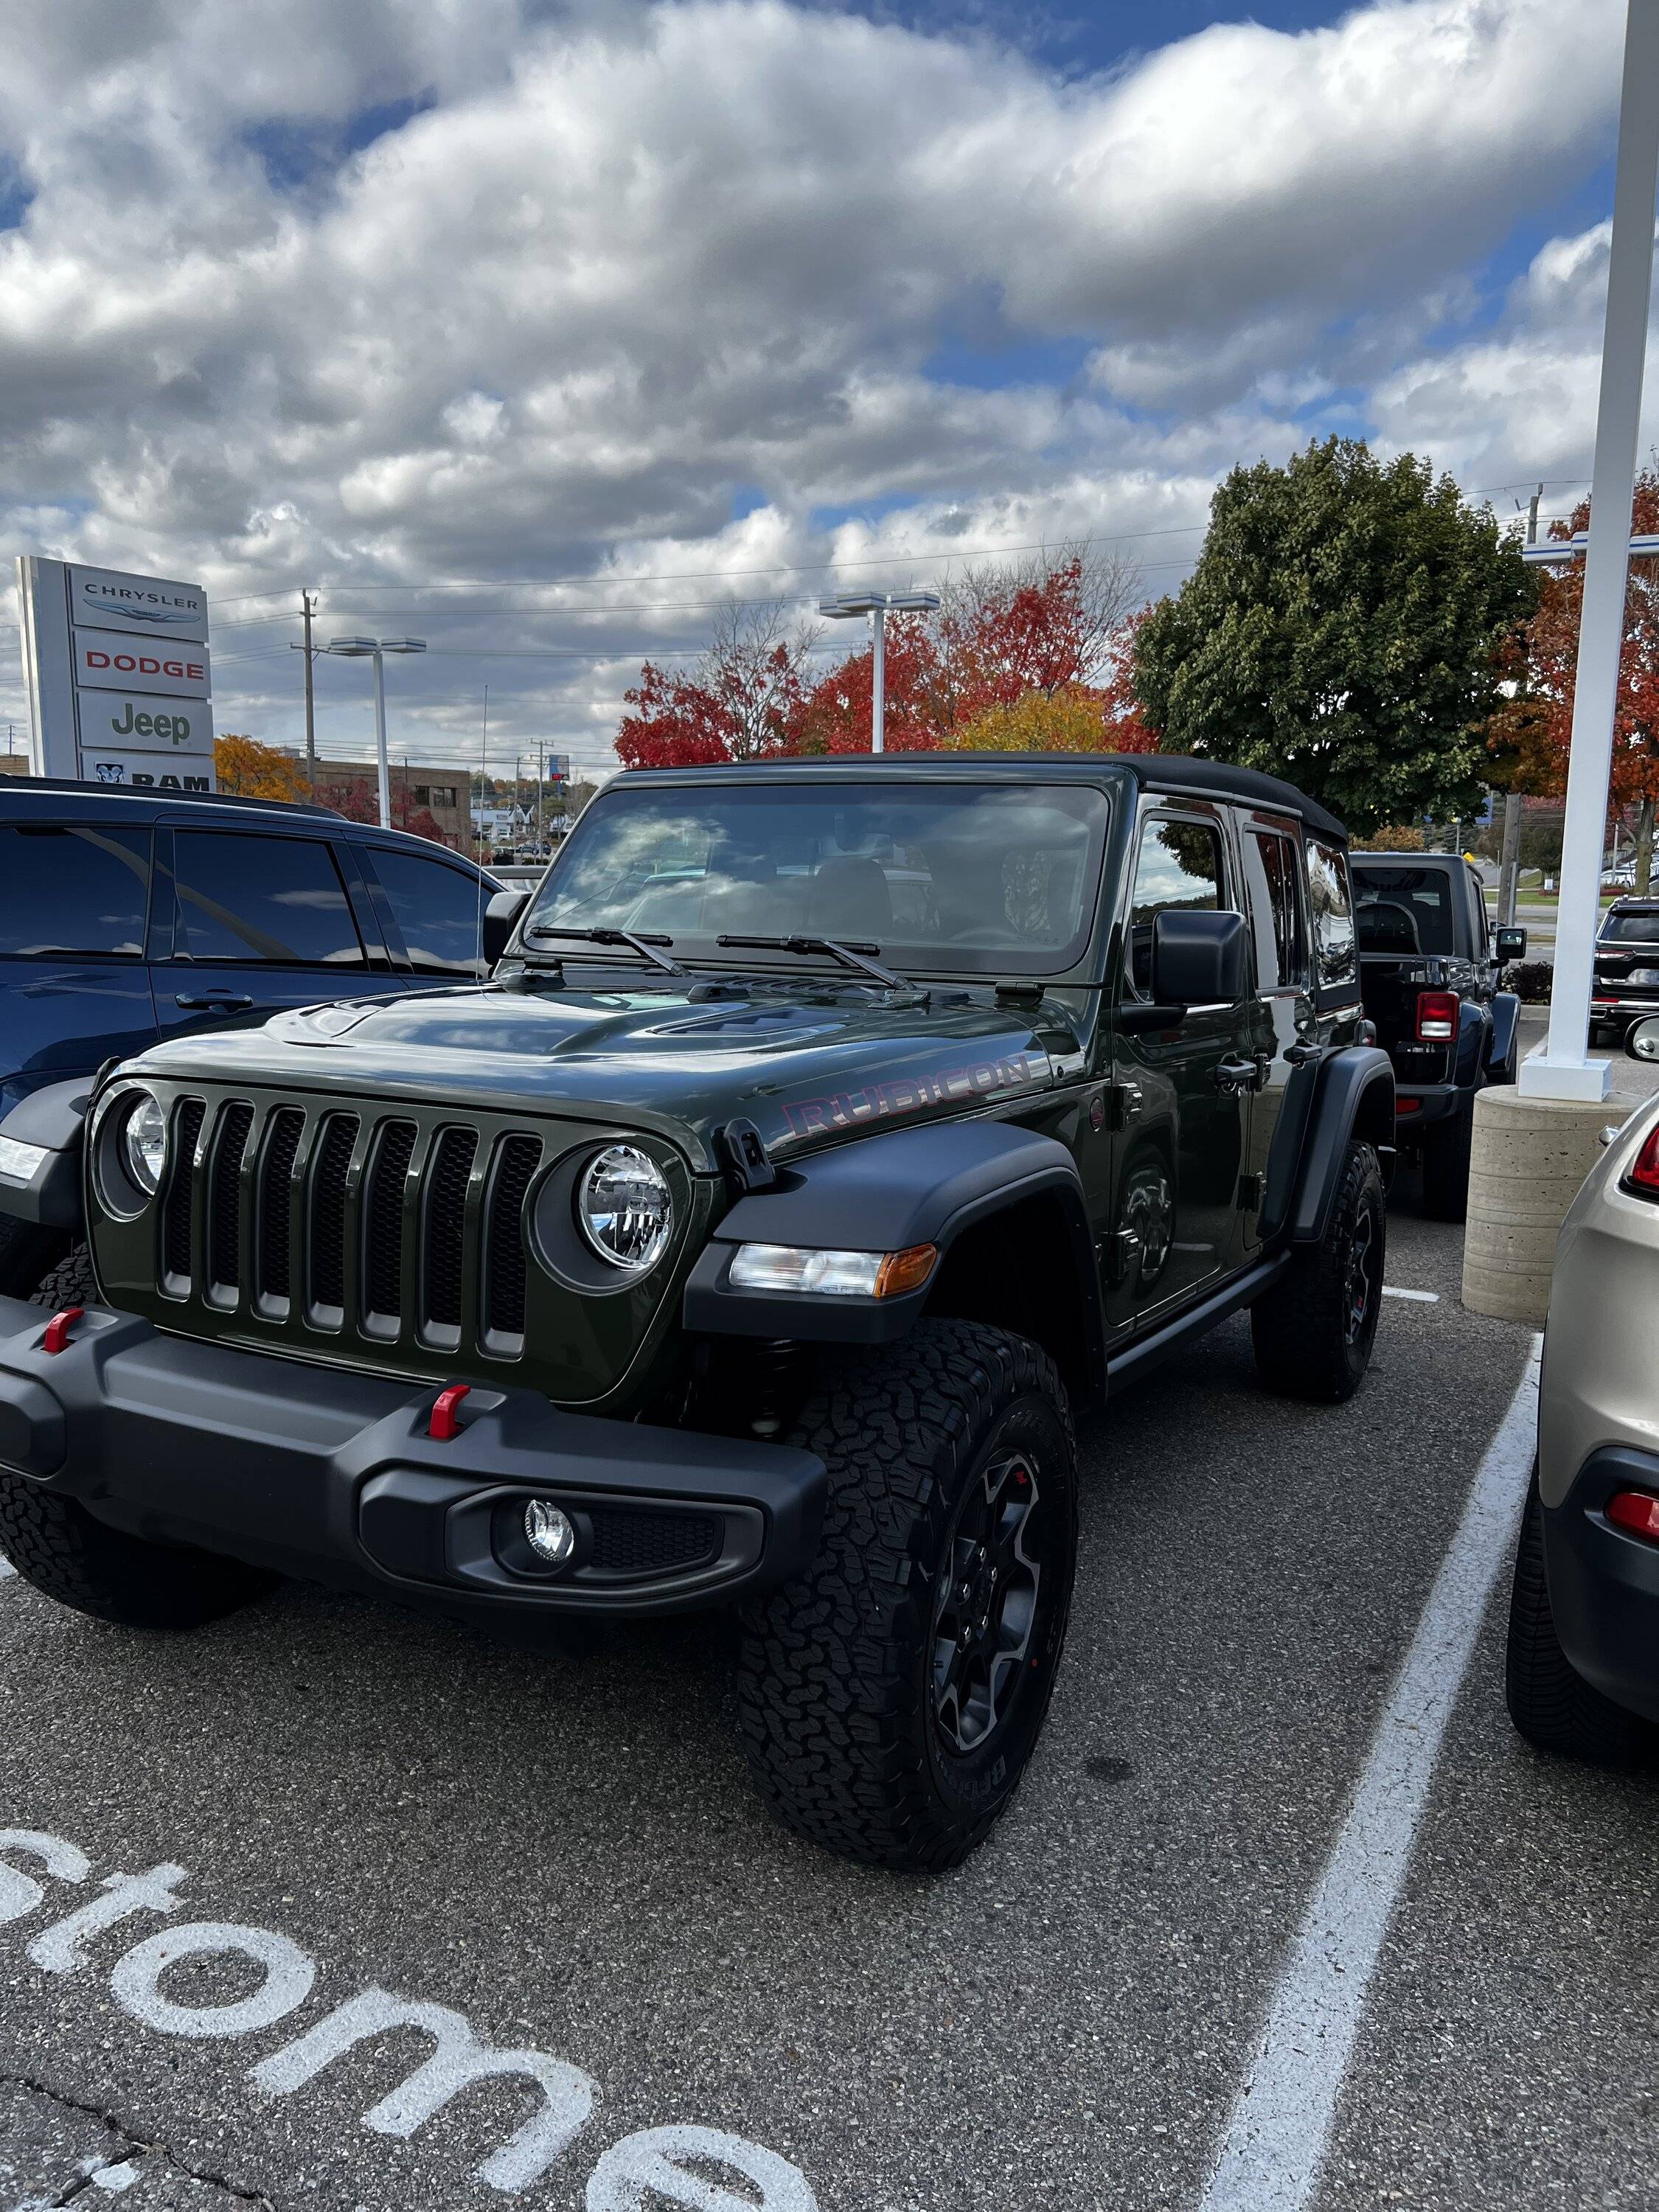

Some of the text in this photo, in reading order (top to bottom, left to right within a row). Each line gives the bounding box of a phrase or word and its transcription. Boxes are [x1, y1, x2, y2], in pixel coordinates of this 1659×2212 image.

[84, 583, 198, 610] CHRYSLER
[86, 651, 204, 680] DODGE
[111, 703, 190, 745] Jeep
[131, 773, 209, 791] RAM
[783, 1056, 1032, 1137] RUBICON
